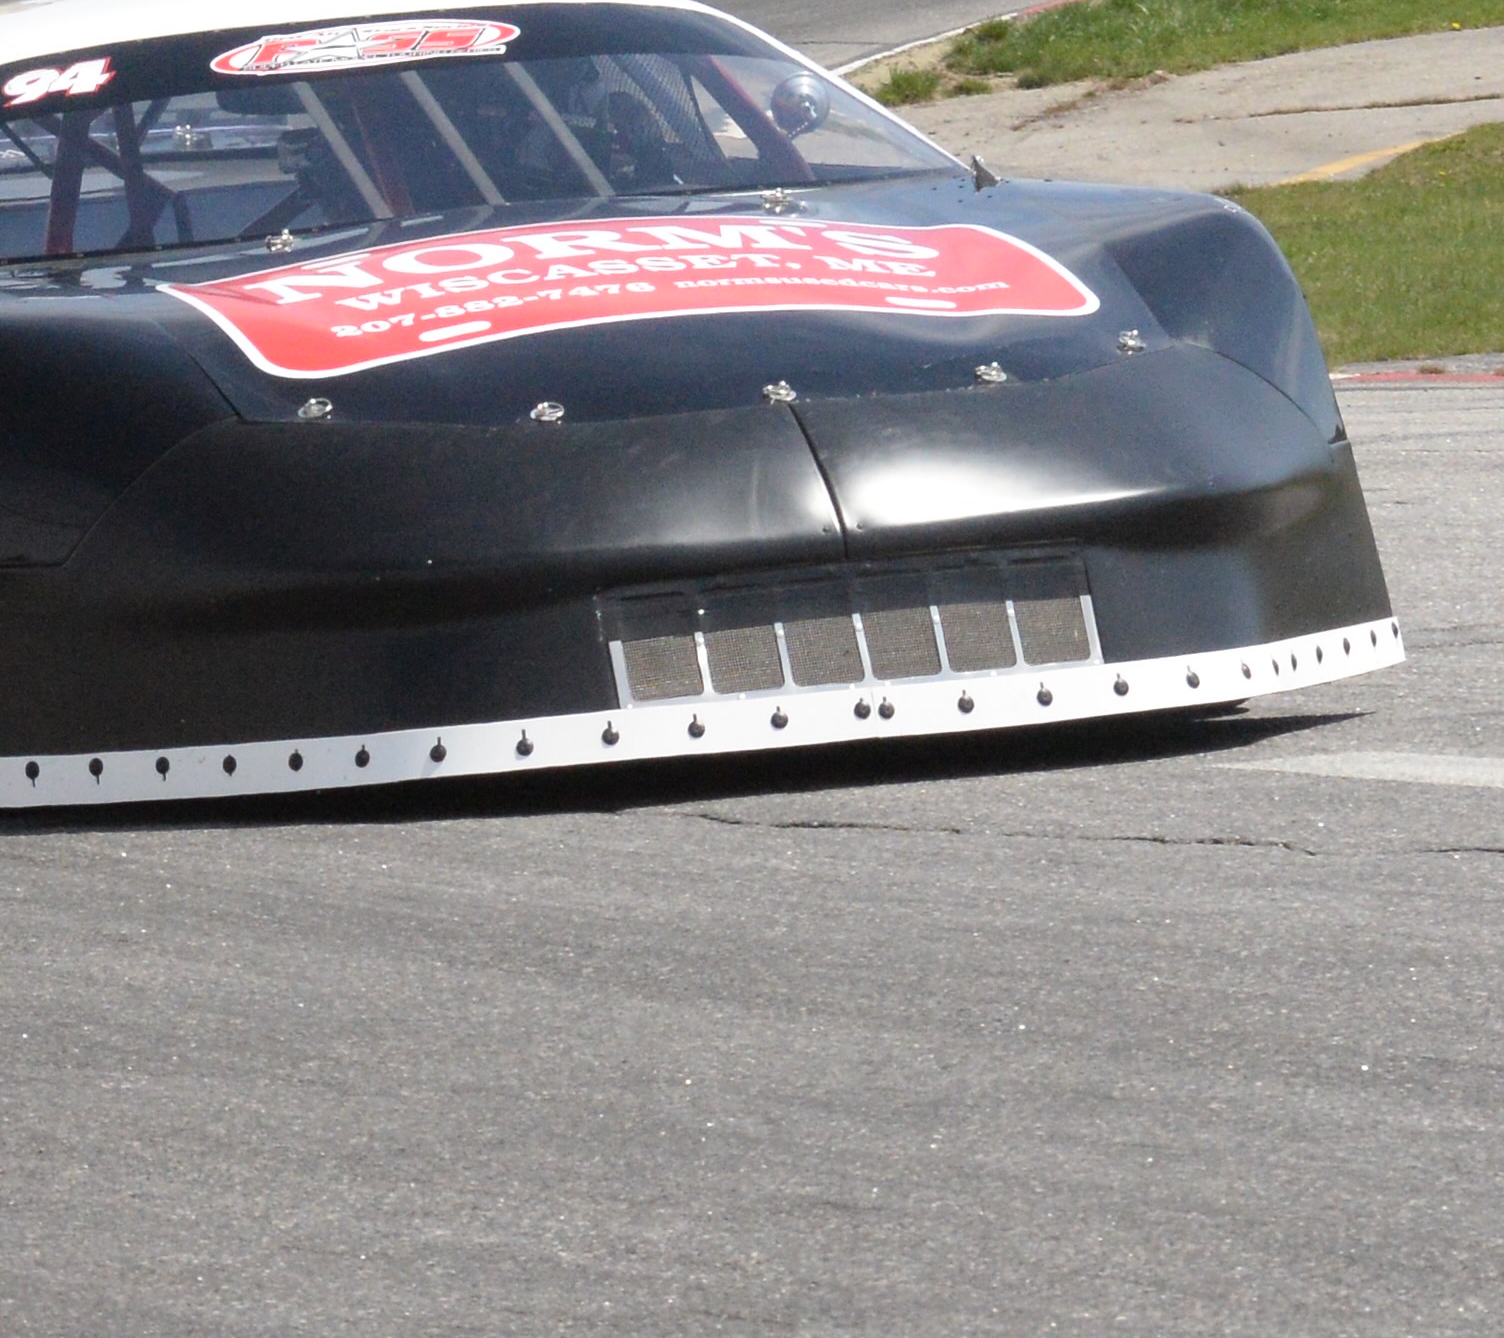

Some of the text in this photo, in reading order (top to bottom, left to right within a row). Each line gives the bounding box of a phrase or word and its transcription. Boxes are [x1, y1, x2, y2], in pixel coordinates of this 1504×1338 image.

[2, 56, 116, 108] 94
[245, 219, 939, 306] NORM'S
[336, 252, 937, 311] WISCASSET, ME
[330, 276, 1010, 338] 207-882-7476 normsusedcars.com
